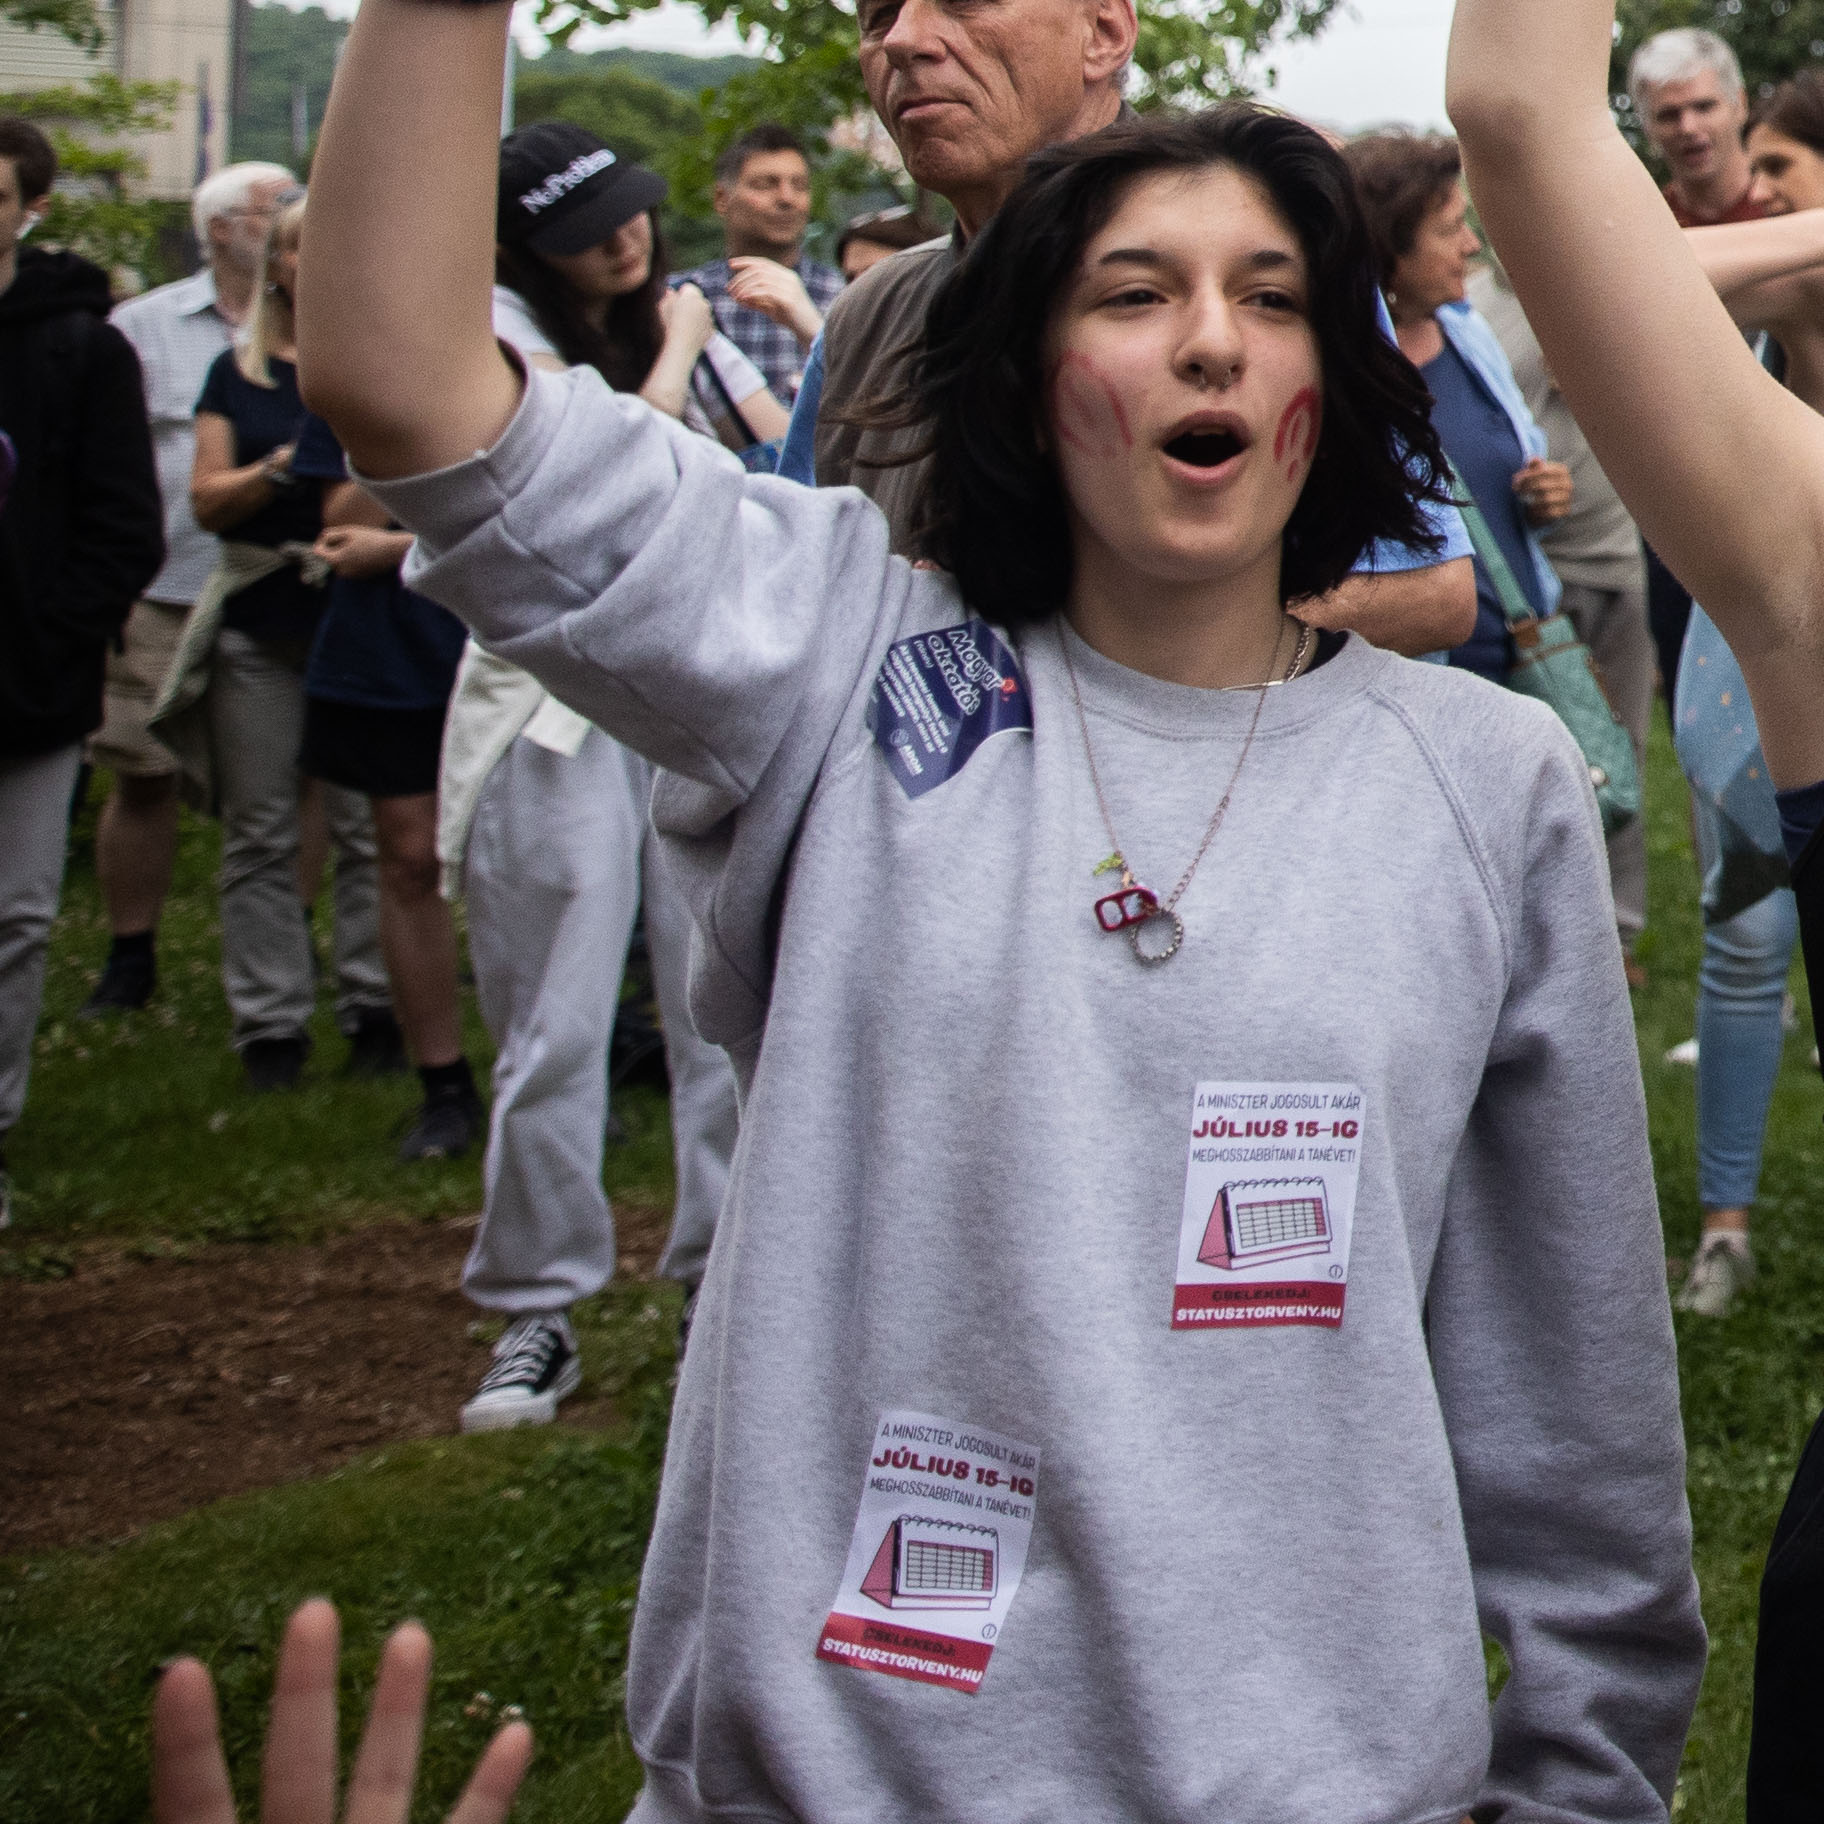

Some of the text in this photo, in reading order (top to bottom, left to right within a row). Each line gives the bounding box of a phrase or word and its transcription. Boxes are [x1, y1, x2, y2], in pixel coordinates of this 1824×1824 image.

[927, 635, 980, 715] oktatás
[948, 630, 1005, 691] Magyar
[1197, 1091, 1360, 1110] A MINISZTER JOGOSULT AKÁR
[1192, 1116, 1288, 1138] JÚLIUS
[1192, 1146, 1355, 1163] MEGHOSSZABBÍTANI A TANÉVET!
[1176, 1305, 1341, 1322] STATUSZTORVENY.HU
[881, 1423, 890, 1438] A
[893, 1425, 953, 1446] MINISZTER
[955, 1433, 1008, 1460] JOGOSULT
[873, 1446, 969, 1480] JÚLIUS
[870, 1478, 1031, 1519] MEGHOSSZABBÍTANI A TANÉVET!
[823, 1637, 984, 1683] STATUSZTORVENY.HU
